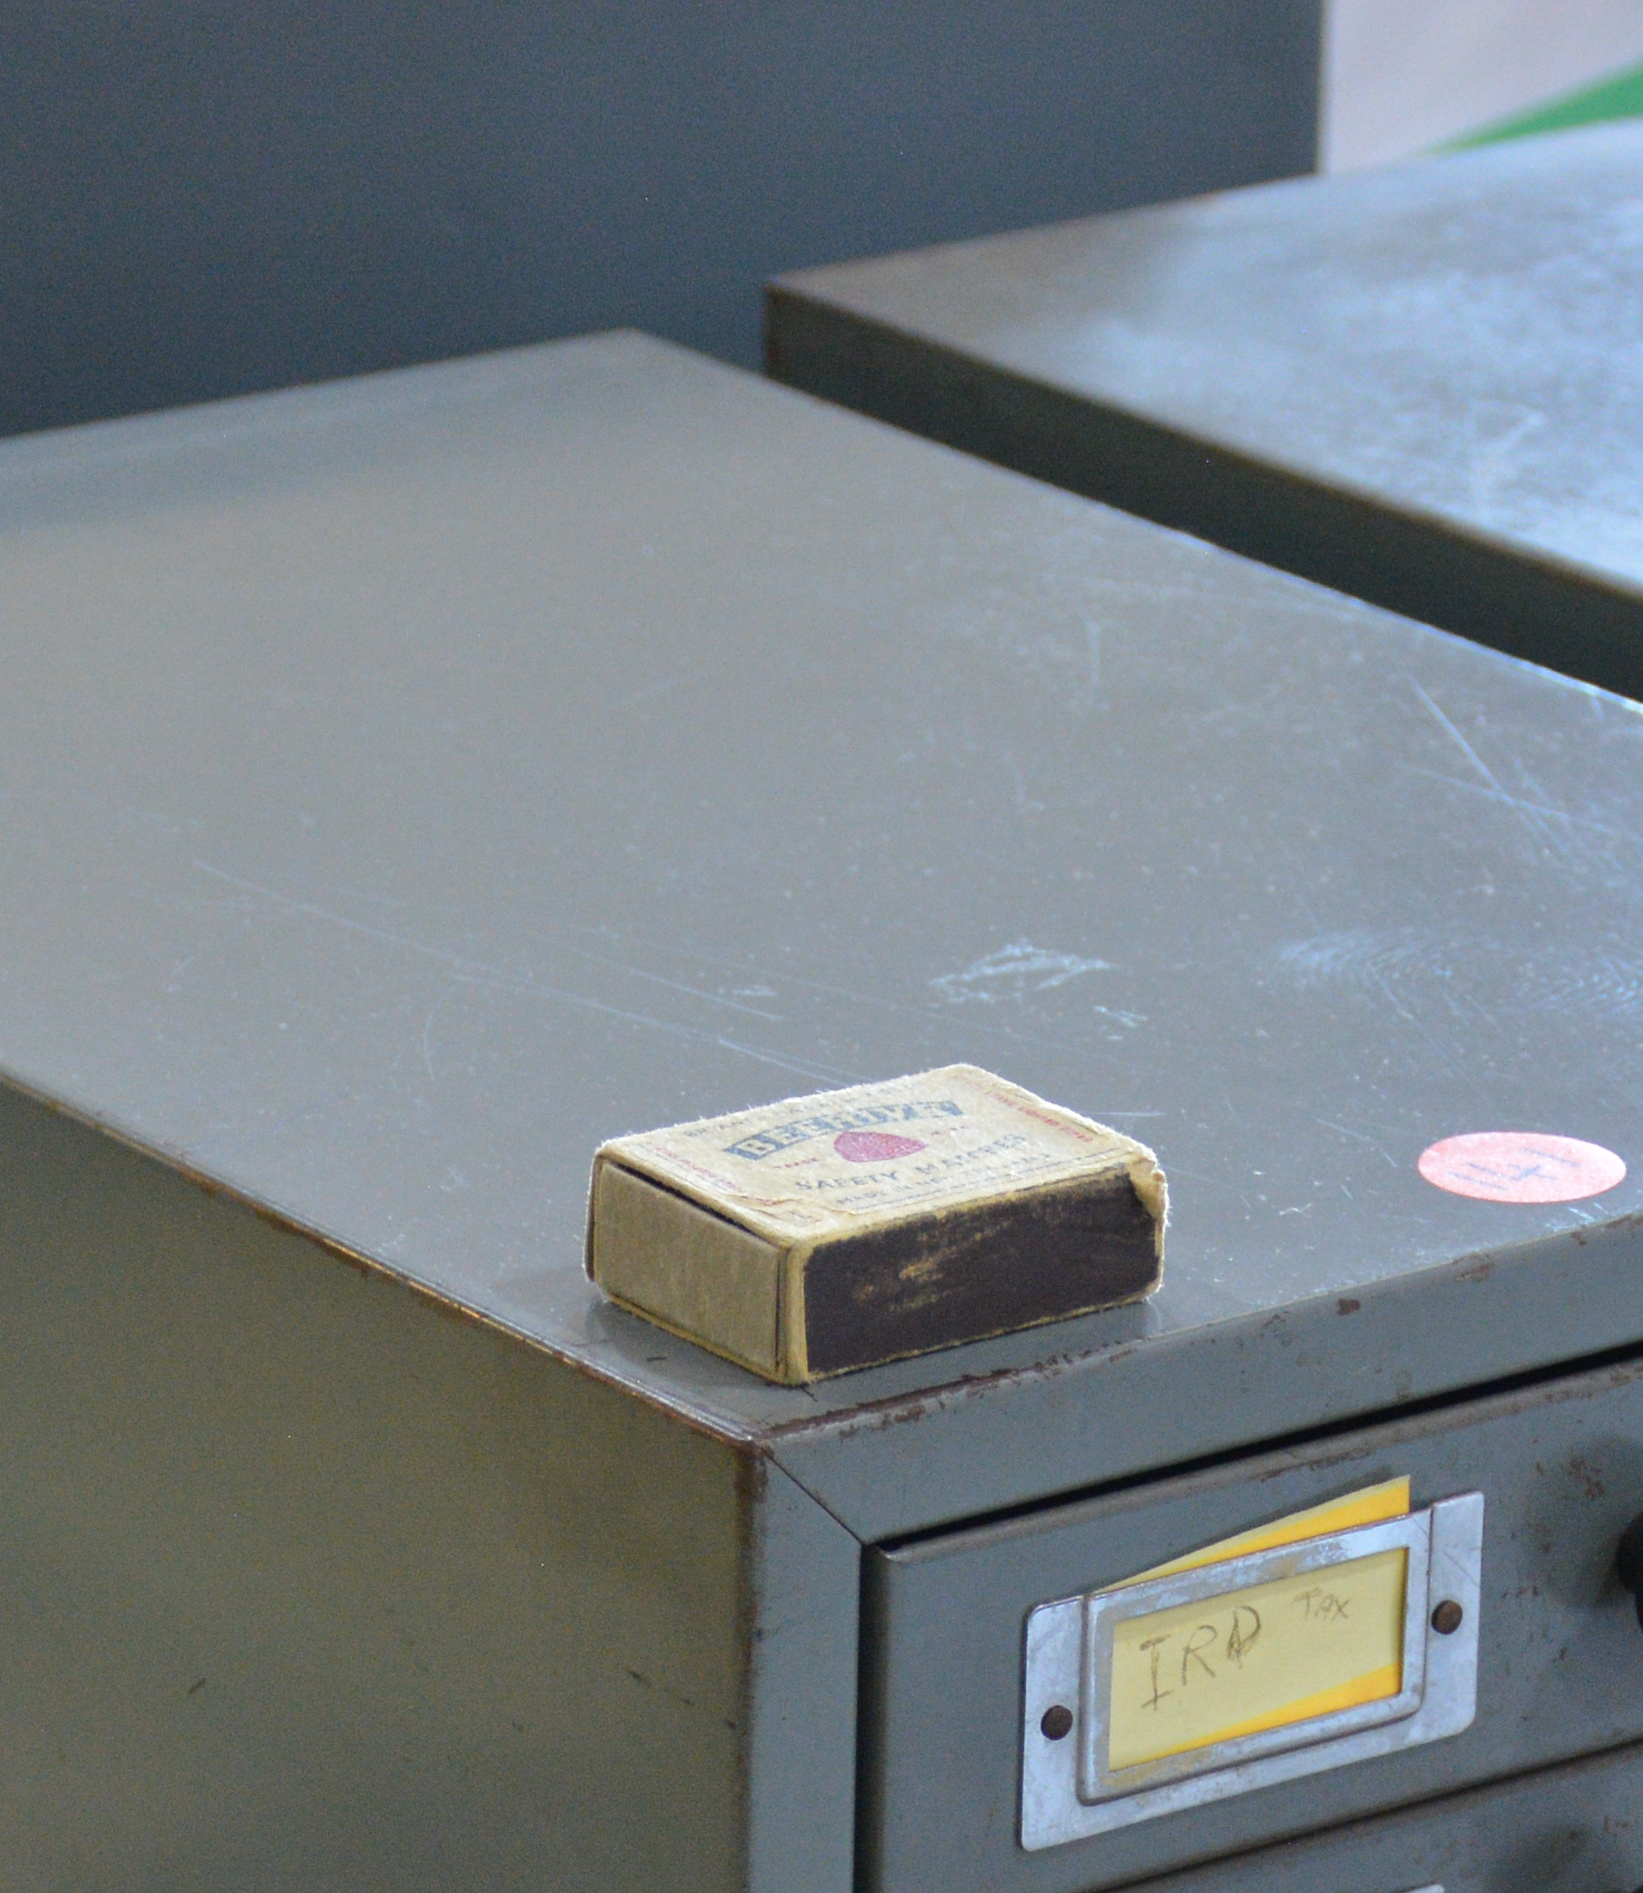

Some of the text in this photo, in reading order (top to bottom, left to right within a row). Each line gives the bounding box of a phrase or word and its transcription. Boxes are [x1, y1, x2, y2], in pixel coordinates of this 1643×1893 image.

[726, 1101, 959, 1159] BEEHIVE
[796, 1132, 1027, 1201] SAFETY MATCHES
